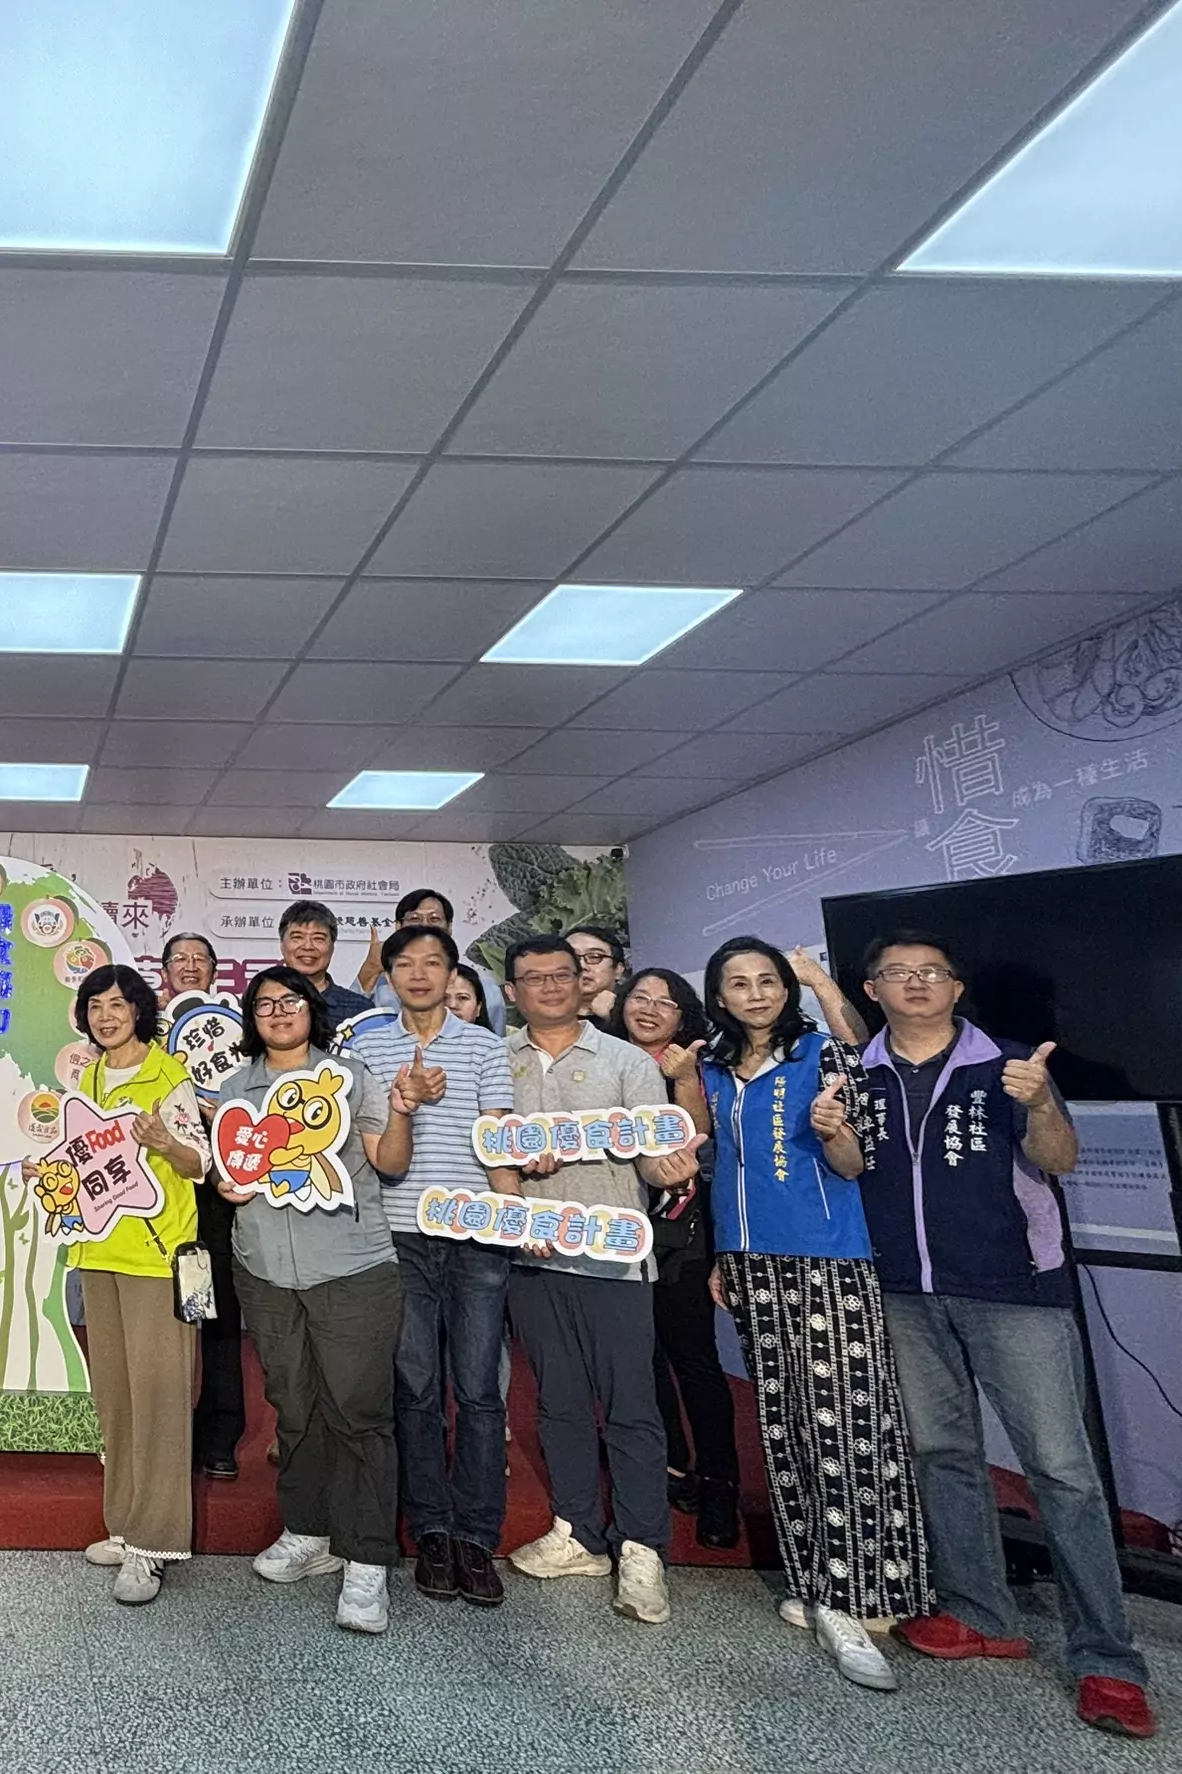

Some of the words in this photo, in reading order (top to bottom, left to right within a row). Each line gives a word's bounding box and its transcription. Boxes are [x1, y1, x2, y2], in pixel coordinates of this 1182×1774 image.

[313, 879, 400, 892] 桃園市政府社會局
[706, 875, 758, 900] Change
[762, 860, 798, 882] Your
[803, 847, 837, 871] Life
[182, 1016, 225, 1052] 珍惜
[234, 1125, 269, 1150] 愛心
[482, 1113, 687, 1155] 桃園優食計畫
[772, 1075, 790, 1183] 陽明社區發展協會
[873, 1097, 890, 1141] 理事長
[943, 1104, 965, 1167] 發展協會
[968, 1089, 989, 1152] 豐林社區
[81, 1153, 132, 1202] 同享
[226, 1149, 263, 1172] 傳遞
[93, 1198, 113, 1213] Sharing
[112, 1188, 126, 1201] Good
[125, 1180, 139, 1193] Food
[425, 1197, 643, 1253] 桃園優食計畫
